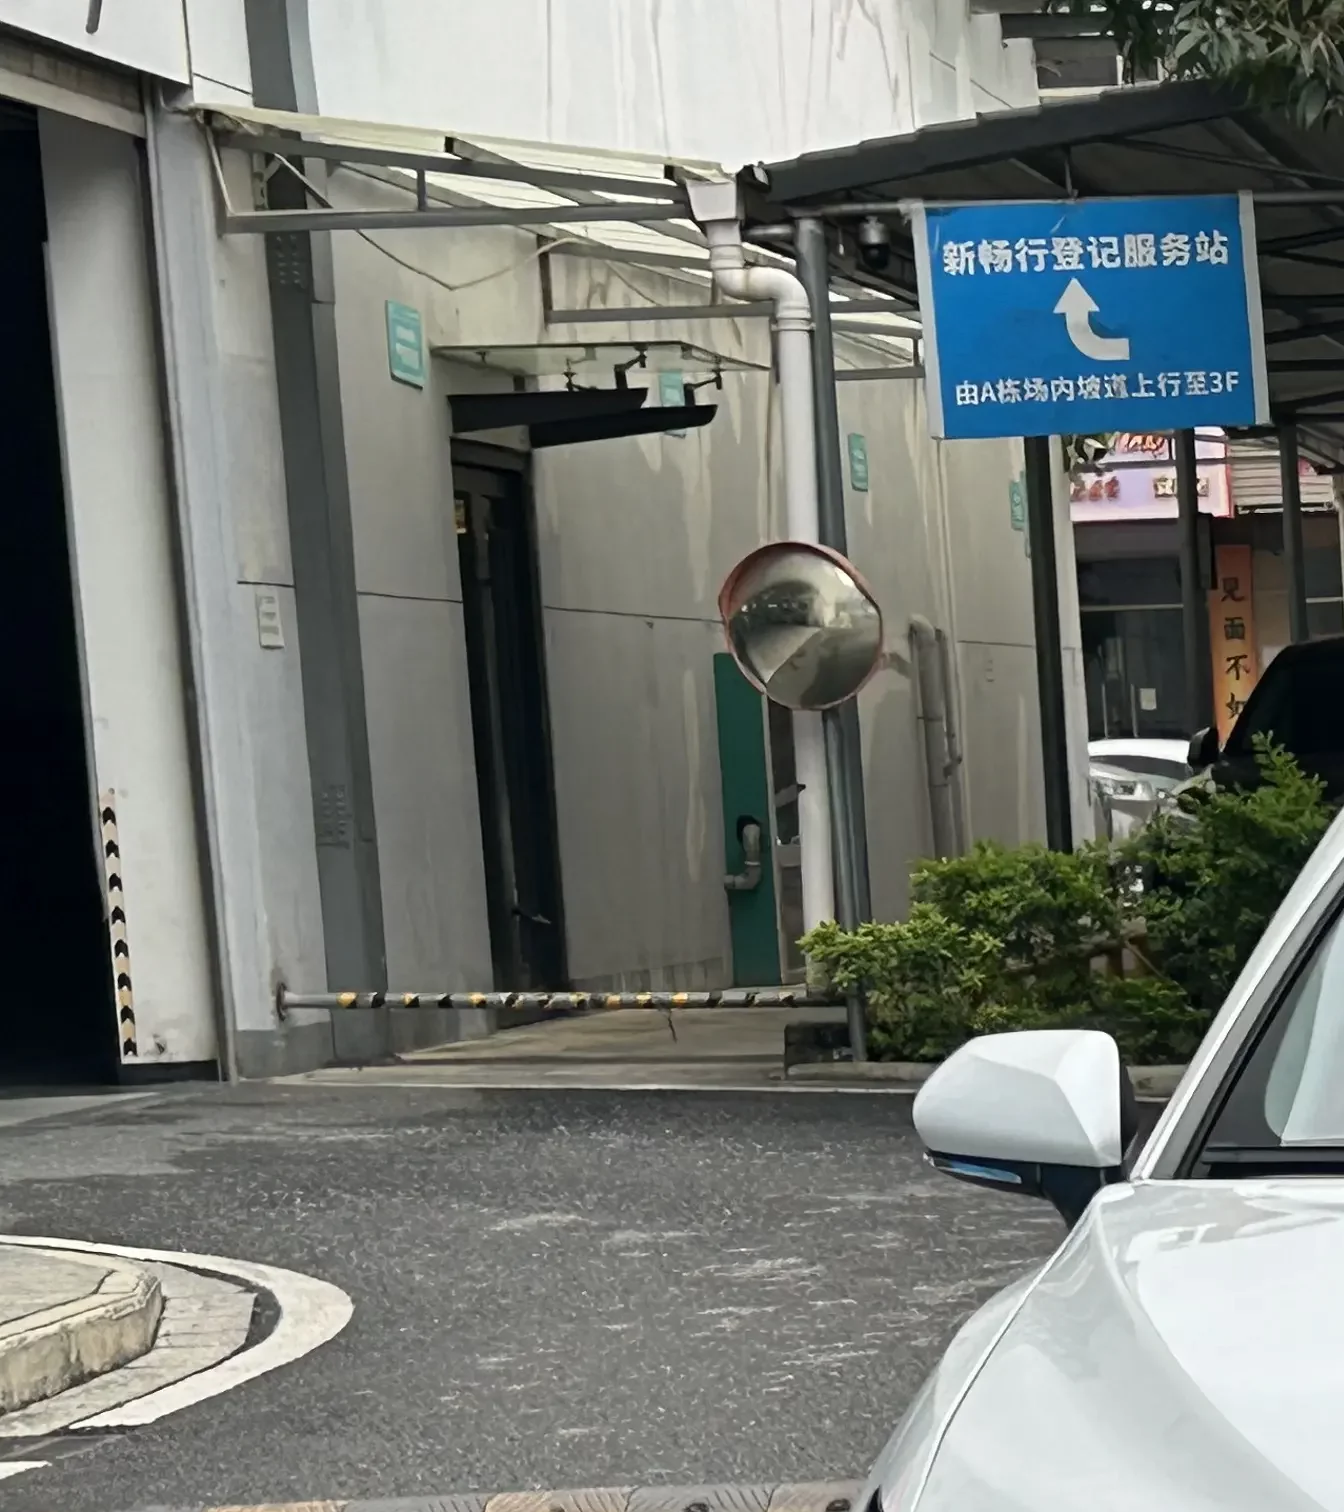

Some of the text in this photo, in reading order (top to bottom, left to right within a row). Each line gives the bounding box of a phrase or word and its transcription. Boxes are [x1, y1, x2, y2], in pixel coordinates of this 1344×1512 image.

[942, 229, 1229, 276] 新畅行登记服务站
[955, 371, 1240, 406] 由A栋场内坡道上行至3F
